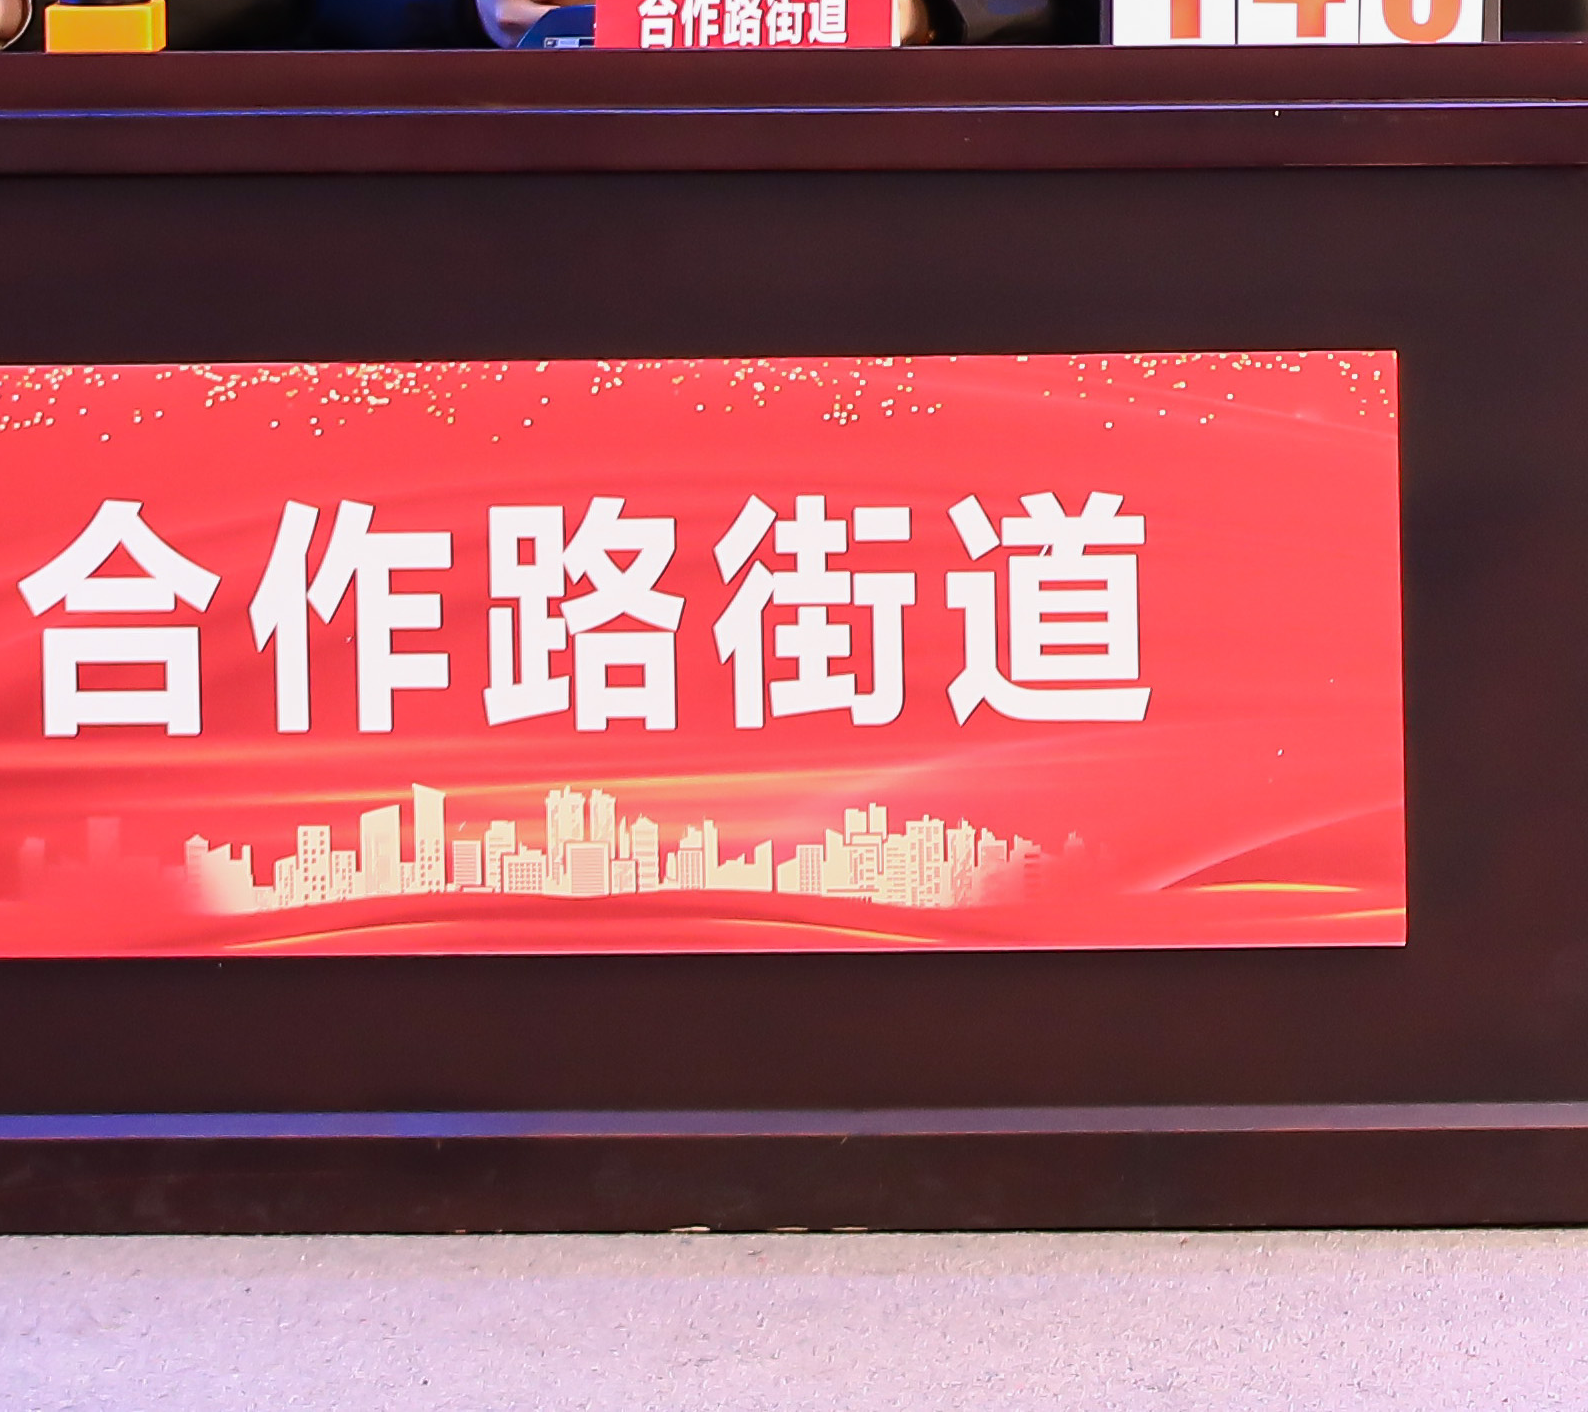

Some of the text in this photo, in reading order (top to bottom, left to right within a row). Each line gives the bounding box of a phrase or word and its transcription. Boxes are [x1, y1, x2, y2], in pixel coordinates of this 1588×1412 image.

[18, 490, 1153, 738] 合作路街道
